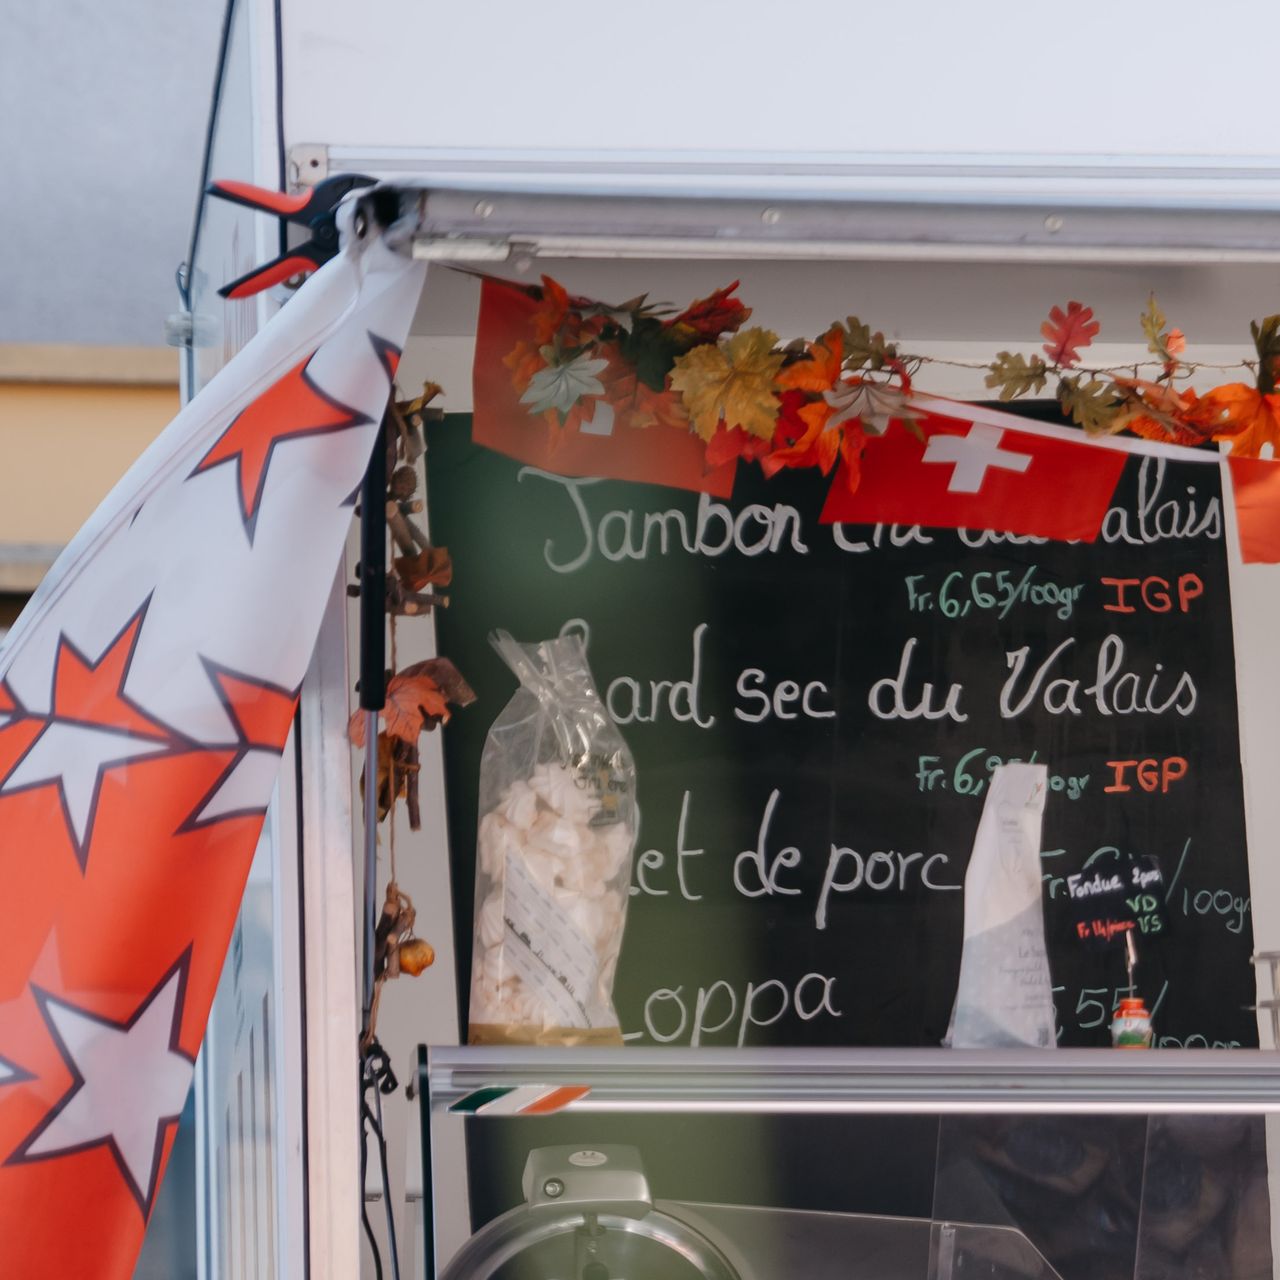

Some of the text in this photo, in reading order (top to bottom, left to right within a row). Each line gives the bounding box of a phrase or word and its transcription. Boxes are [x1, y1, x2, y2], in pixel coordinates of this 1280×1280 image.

[518, 455, 1224, 573] Jambon alais
[1101, 573, 1204, 613] IGP
[734, 668, 836, 722] sec
[867, 637, 968, 722] du
[1000, 633, 1198, 719] Valais
[1104, 756, 1188, 793] IGP
[733, 789, 801, 898] de
[815, 843, 962, 929] porc
[1067, 873, 1122, 899] Fondue
[624, 973, 841, 1047] oppa
